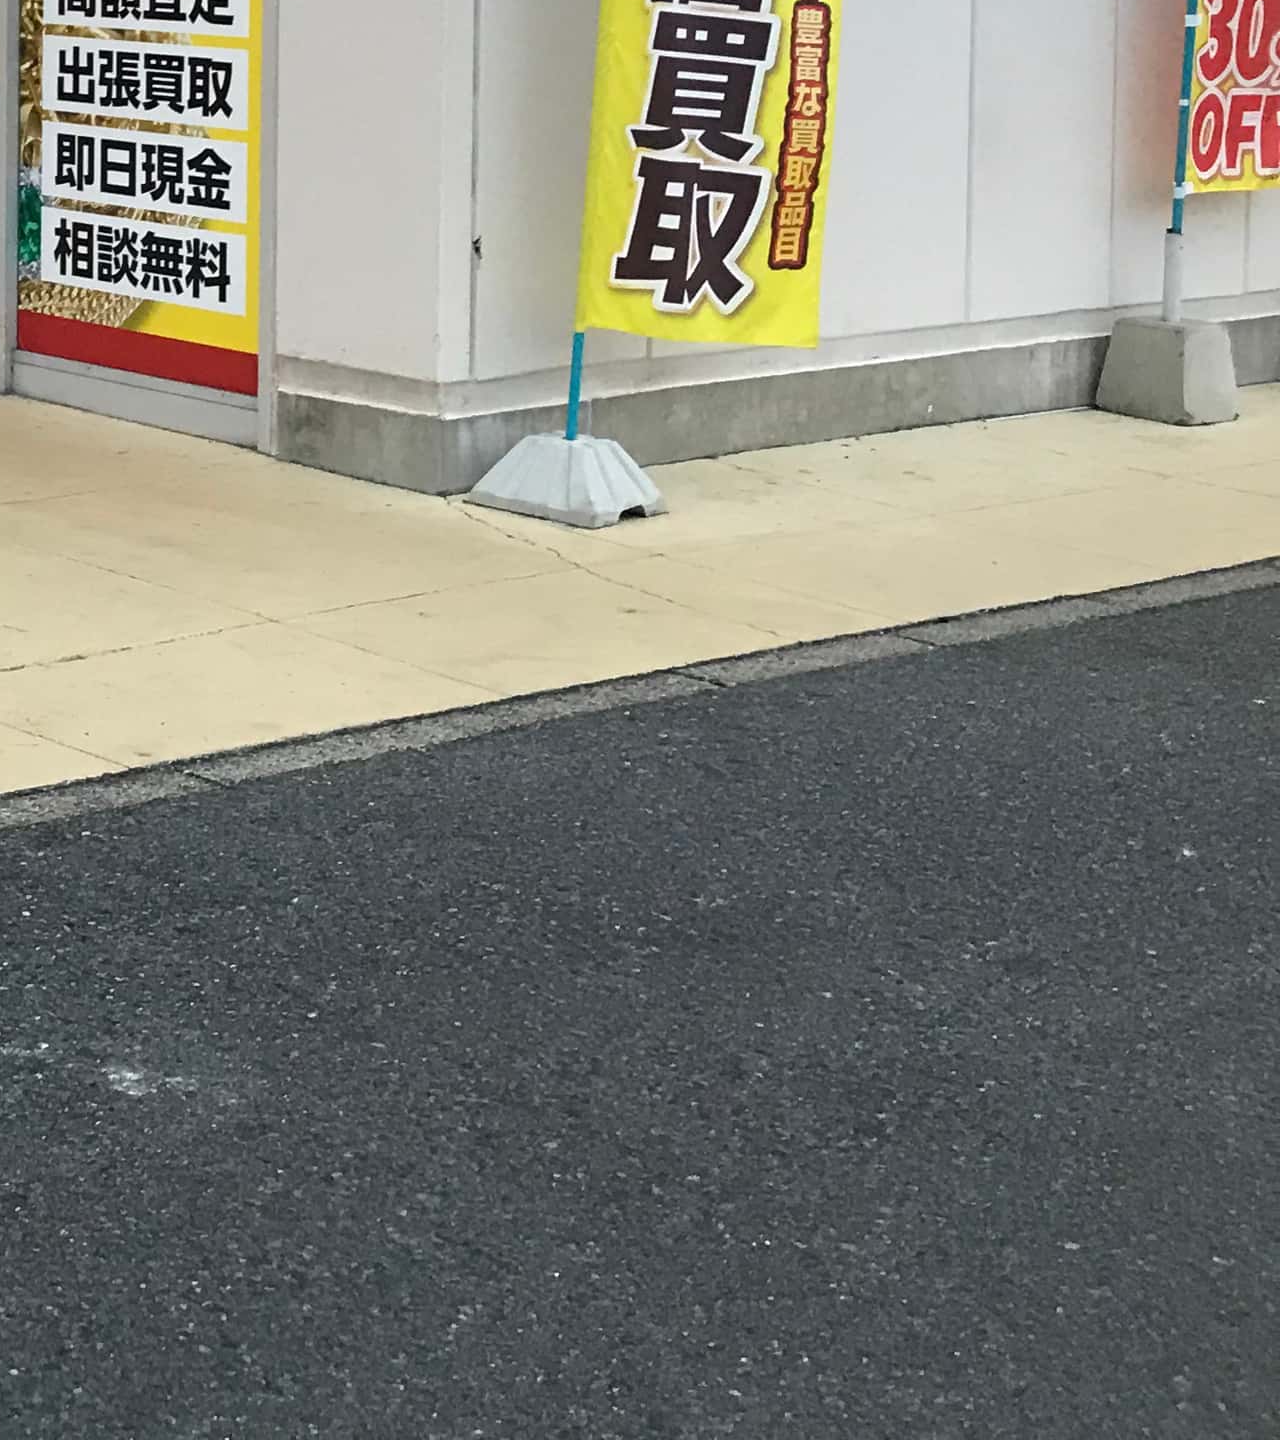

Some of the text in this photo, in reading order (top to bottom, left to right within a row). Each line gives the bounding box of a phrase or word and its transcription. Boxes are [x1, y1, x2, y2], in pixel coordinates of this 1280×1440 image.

[57, 46, 233, 118] 出張買取
[55, 133, 232, 210] 即日現金
[54, 218, 231, 303] 相談無料
